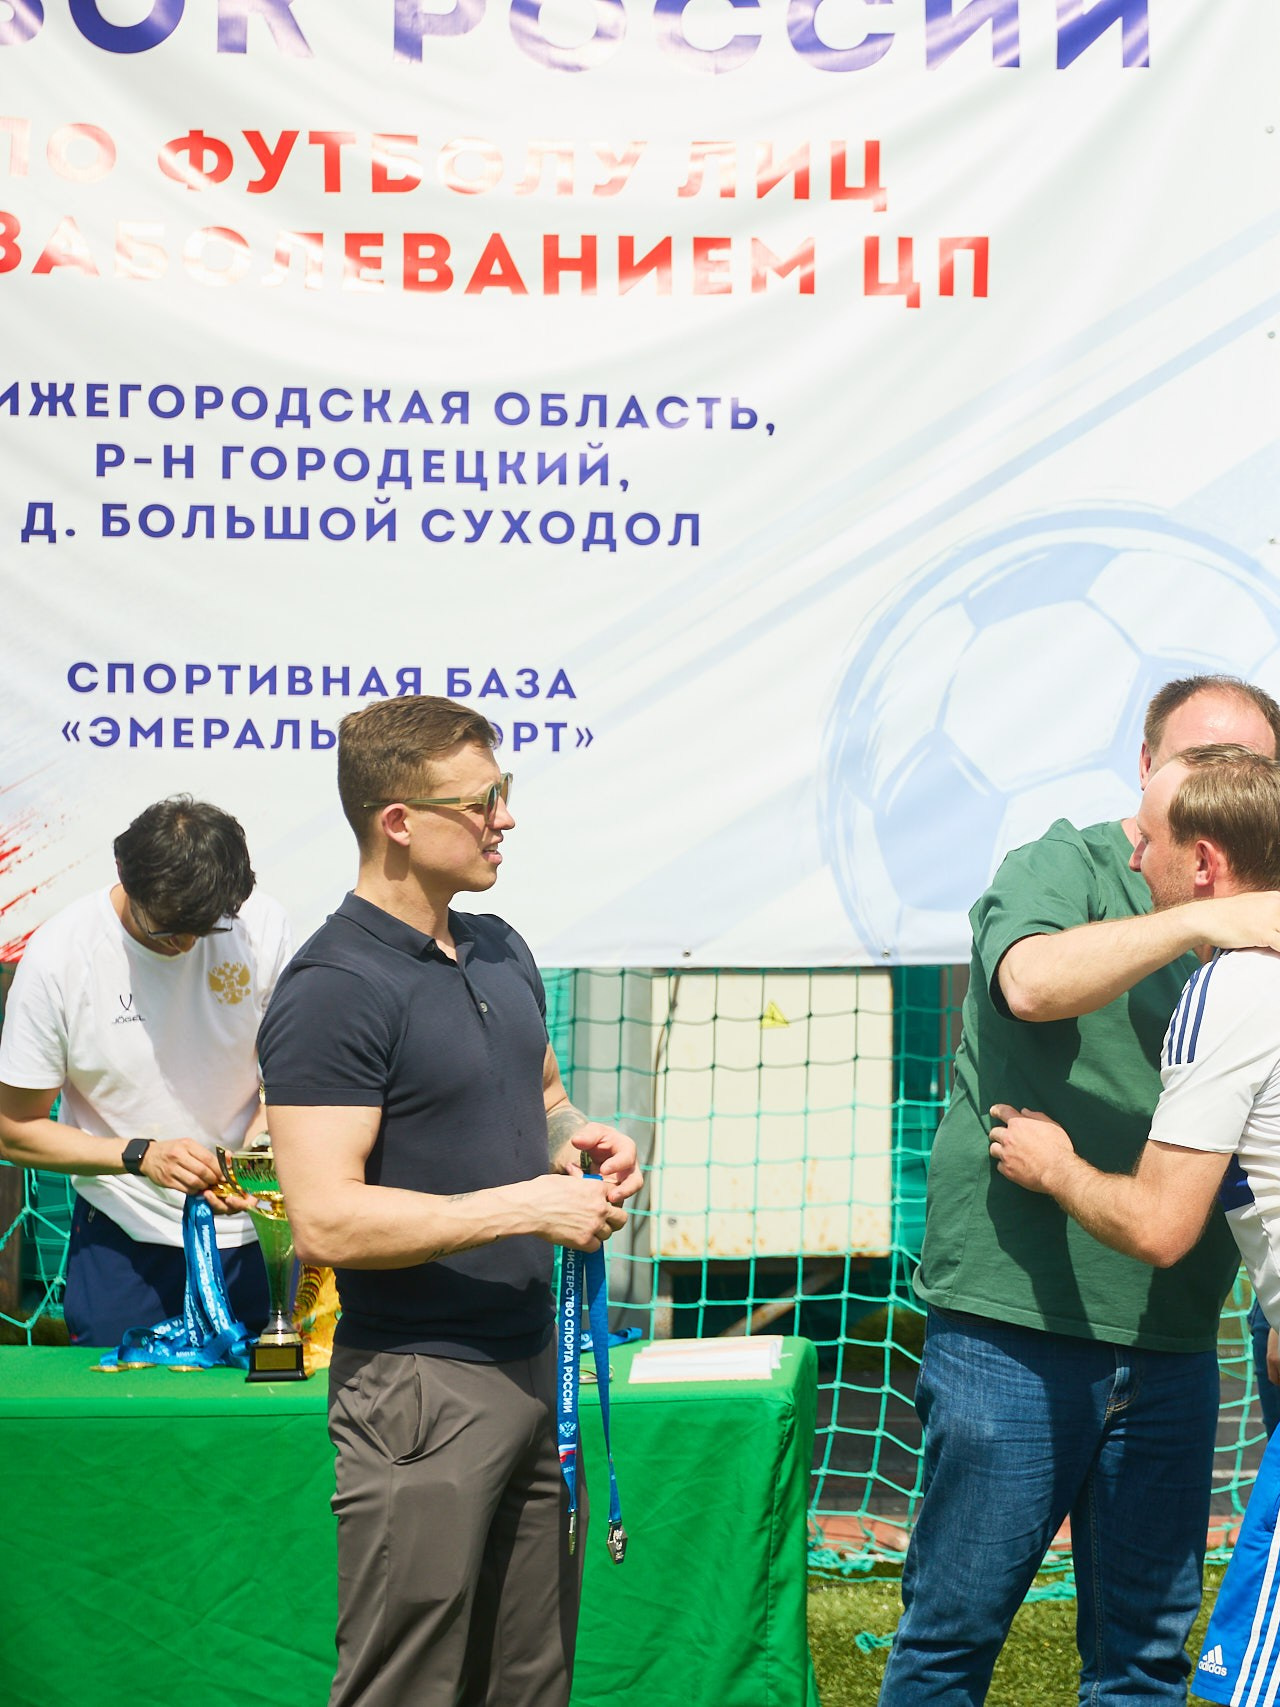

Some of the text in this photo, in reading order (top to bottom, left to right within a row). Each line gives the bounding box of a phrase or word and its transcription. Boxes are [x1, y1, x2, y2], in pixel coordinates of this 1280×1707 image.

[0, 0, 1150, 74] ОК РОССИИ
[157, 129, 648, 196] ФУТБОЛУ
[676, 139, 889, 213] ЛИЦ
[863, 235, 990, 309] ЦП
[0, 381, 776, 434] ИЖЕГОРОДСКАЯ ОБЛАСТЬ,
[96, 443, 629, 491] Р-Н ГОРОДЕЦКИЙ,
[21, 498, 700, 552] Д. БОЛЬШОЙ СУХОДОЛ
[66, 661, 577, 699] СПОРТИВНАЯ БАЗА
[61, 716, 337, 749] «ЭМЕРАЛЬ
[562, 1248, 576, 1413] НИСТЕРСТВО СПОРТА РОССИИ
[1199, 1661, 1228, 1677] adidas
